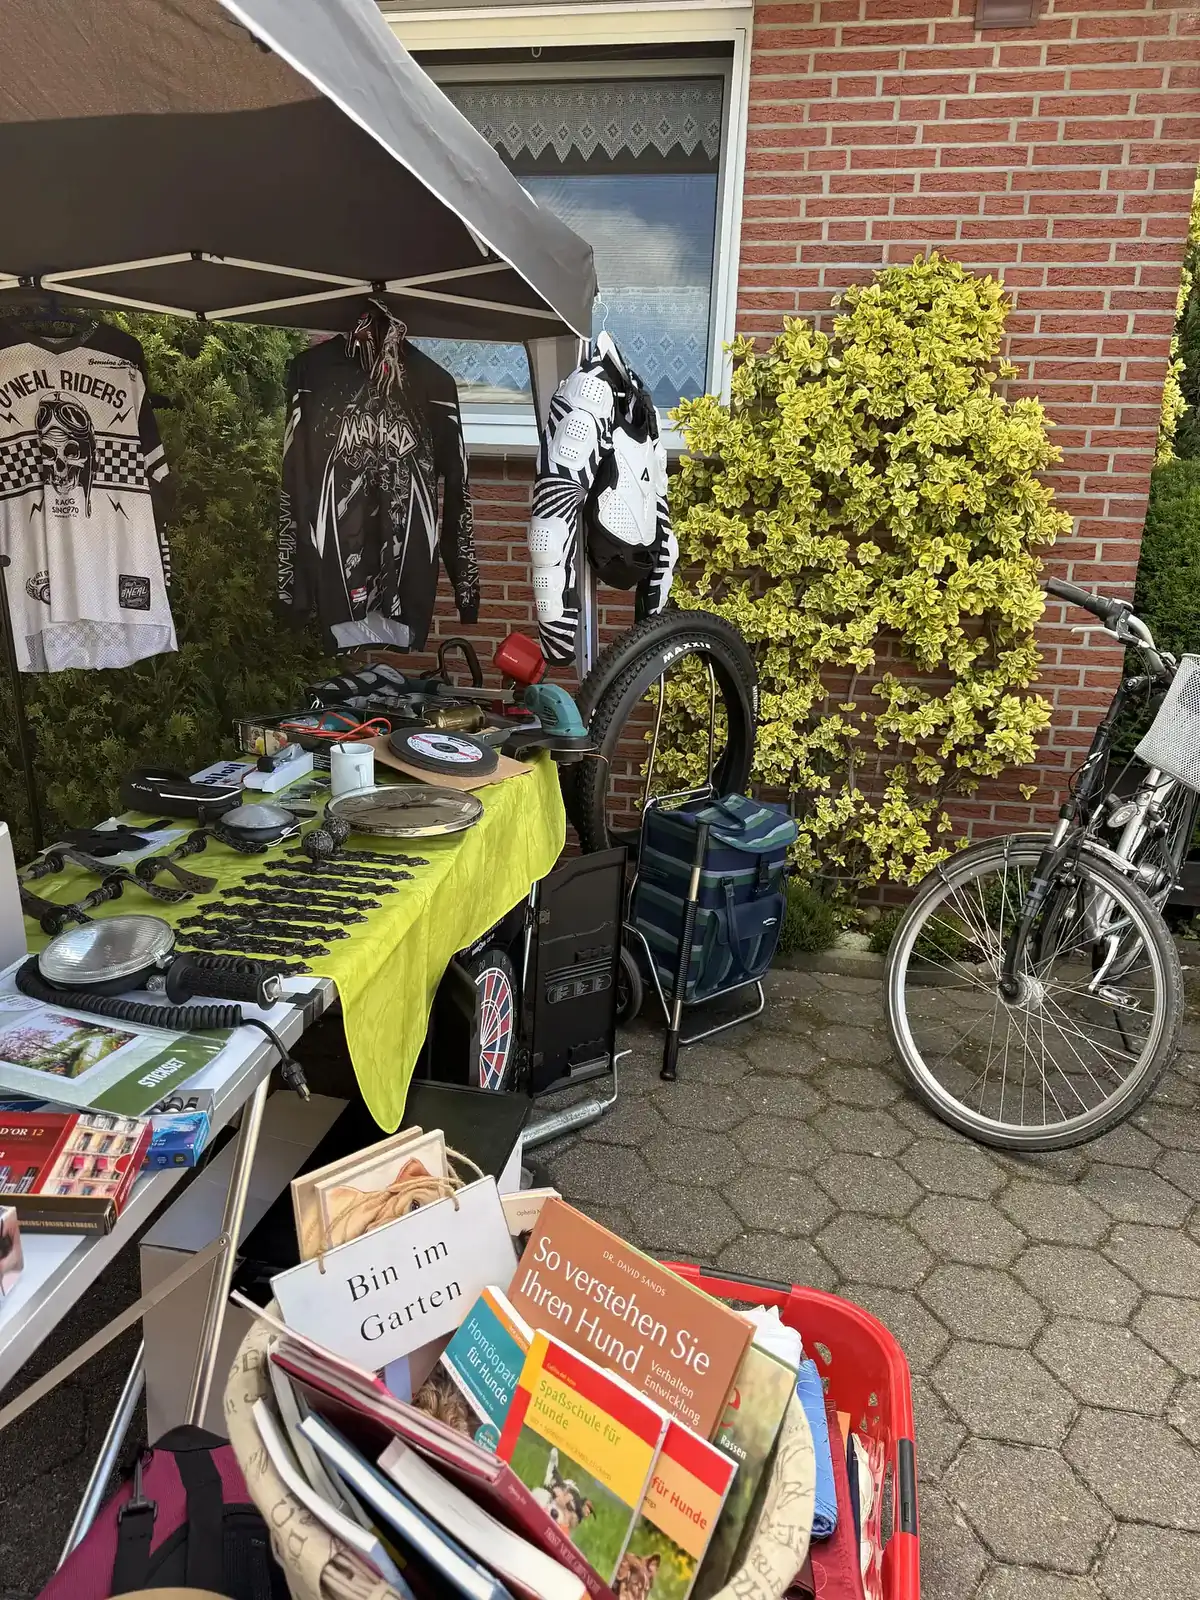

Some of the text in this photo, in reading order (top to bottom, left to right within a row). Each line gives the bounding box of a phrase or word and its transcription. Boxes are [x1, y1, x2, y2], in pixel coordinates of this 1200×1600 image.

[60, 369, 127, 409] RIDERS
[137, 1057, 187, 1088] STICKSET
[0, 1127, 45, 1136] D'OR 12
[346, 1240, 449, 1302] Bin im
[602, 1249, 667, 1297] DR. DAVID SANDS
[360, 1280, 462, 1341] Garten
[520, 1268, 573, 1325] Ihren
[575, 1307, 644, 1374] Hund
[533, 1236, 561, 1271] So
[565, 1260, 668, 1347] verstehen
[670, 1329, 711, 1376] Sie
[466, 1346, 482, 1368] für
[478, 1362, 508, 1406] Hunde
[644, 1374, 702, 1427] Entwicklung
[650, 1359, 694, 1400] Verhalten
[533, 1396, 570, 1430] Hunde
[539, 1379, 602, 1433] Spaßschule
[602, 1423, 622, 1446] für
[720, 1434, 748, 1460] Rassen
[651, 1476, 670, 1498] für
[669, 1491, 708, 1530] Hunde
